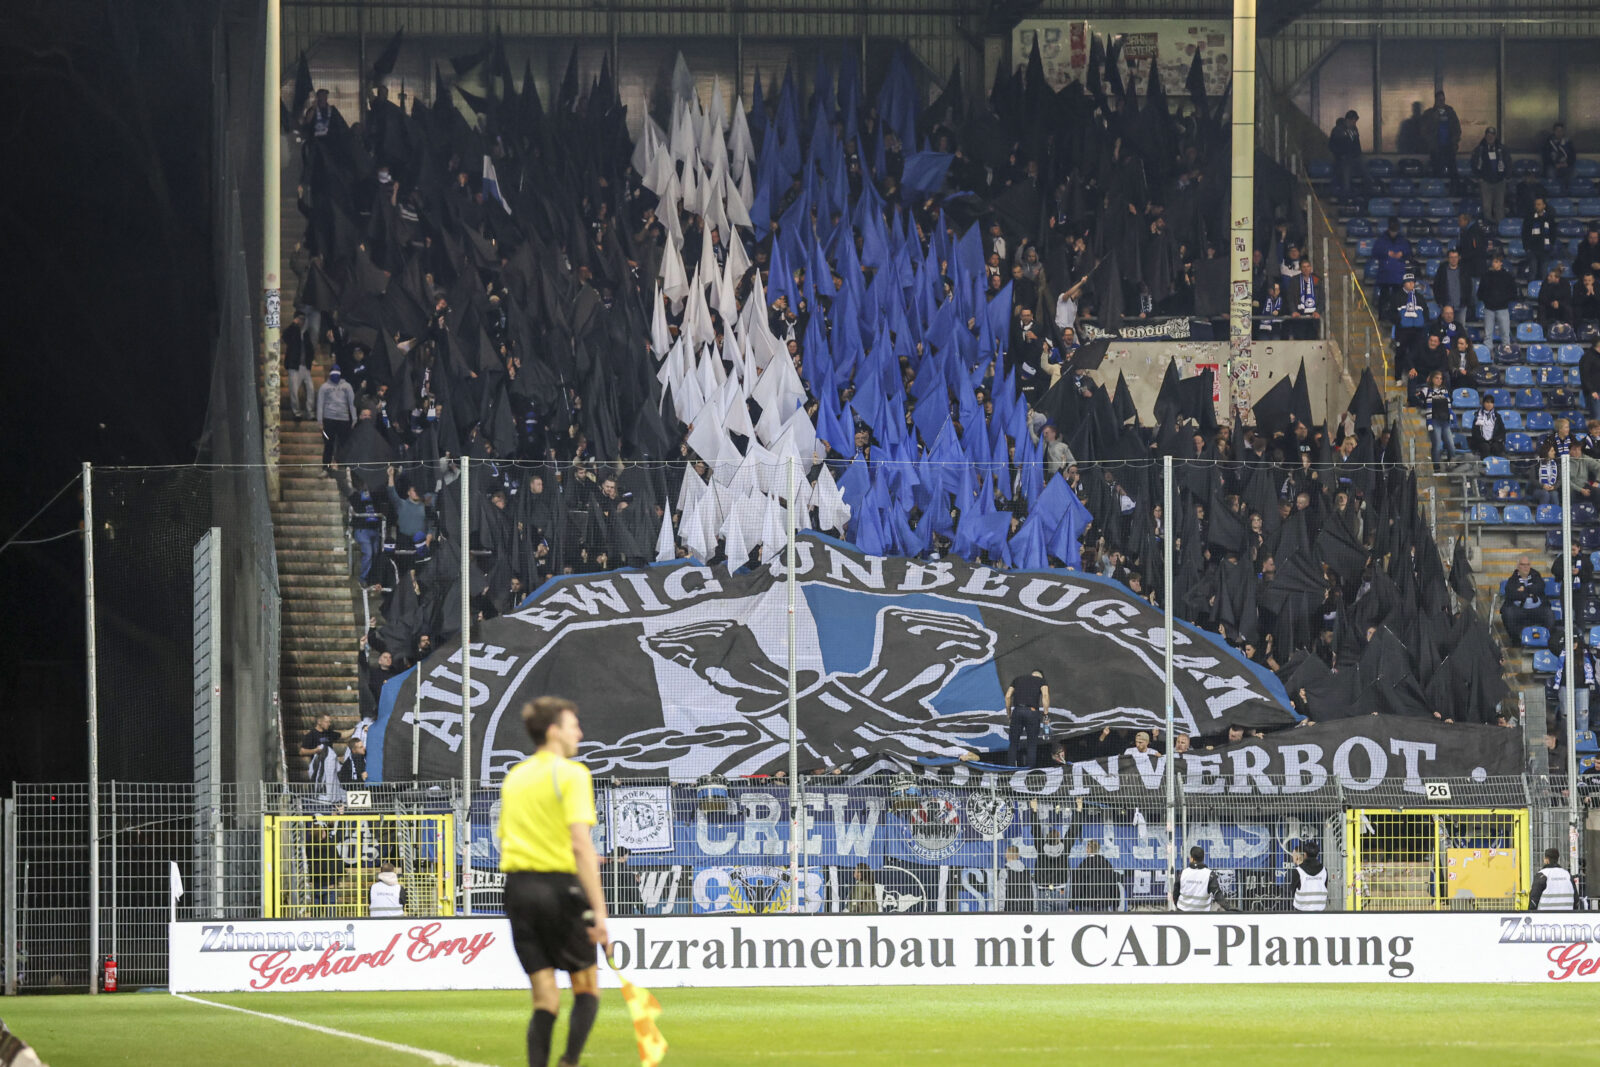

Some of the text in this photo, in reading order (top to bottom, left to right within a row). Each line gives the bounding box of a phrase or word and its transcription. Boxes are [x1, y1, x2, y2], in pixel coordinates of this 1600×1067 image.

[402, 642, 520, 753] AUF
[501, 565, 724, 633] EWIG
[349, 793, 368, 805] 27
[1428, 784, 1448, 797] 26
[696, 792, 885, 857] CREW
[200, 923, 356, 952] Zimmerei
[249, 922, 495, 990] Gerhard Erny
[599, 924, 1415, 979] olzrahmenbau mit CAD-Planung
